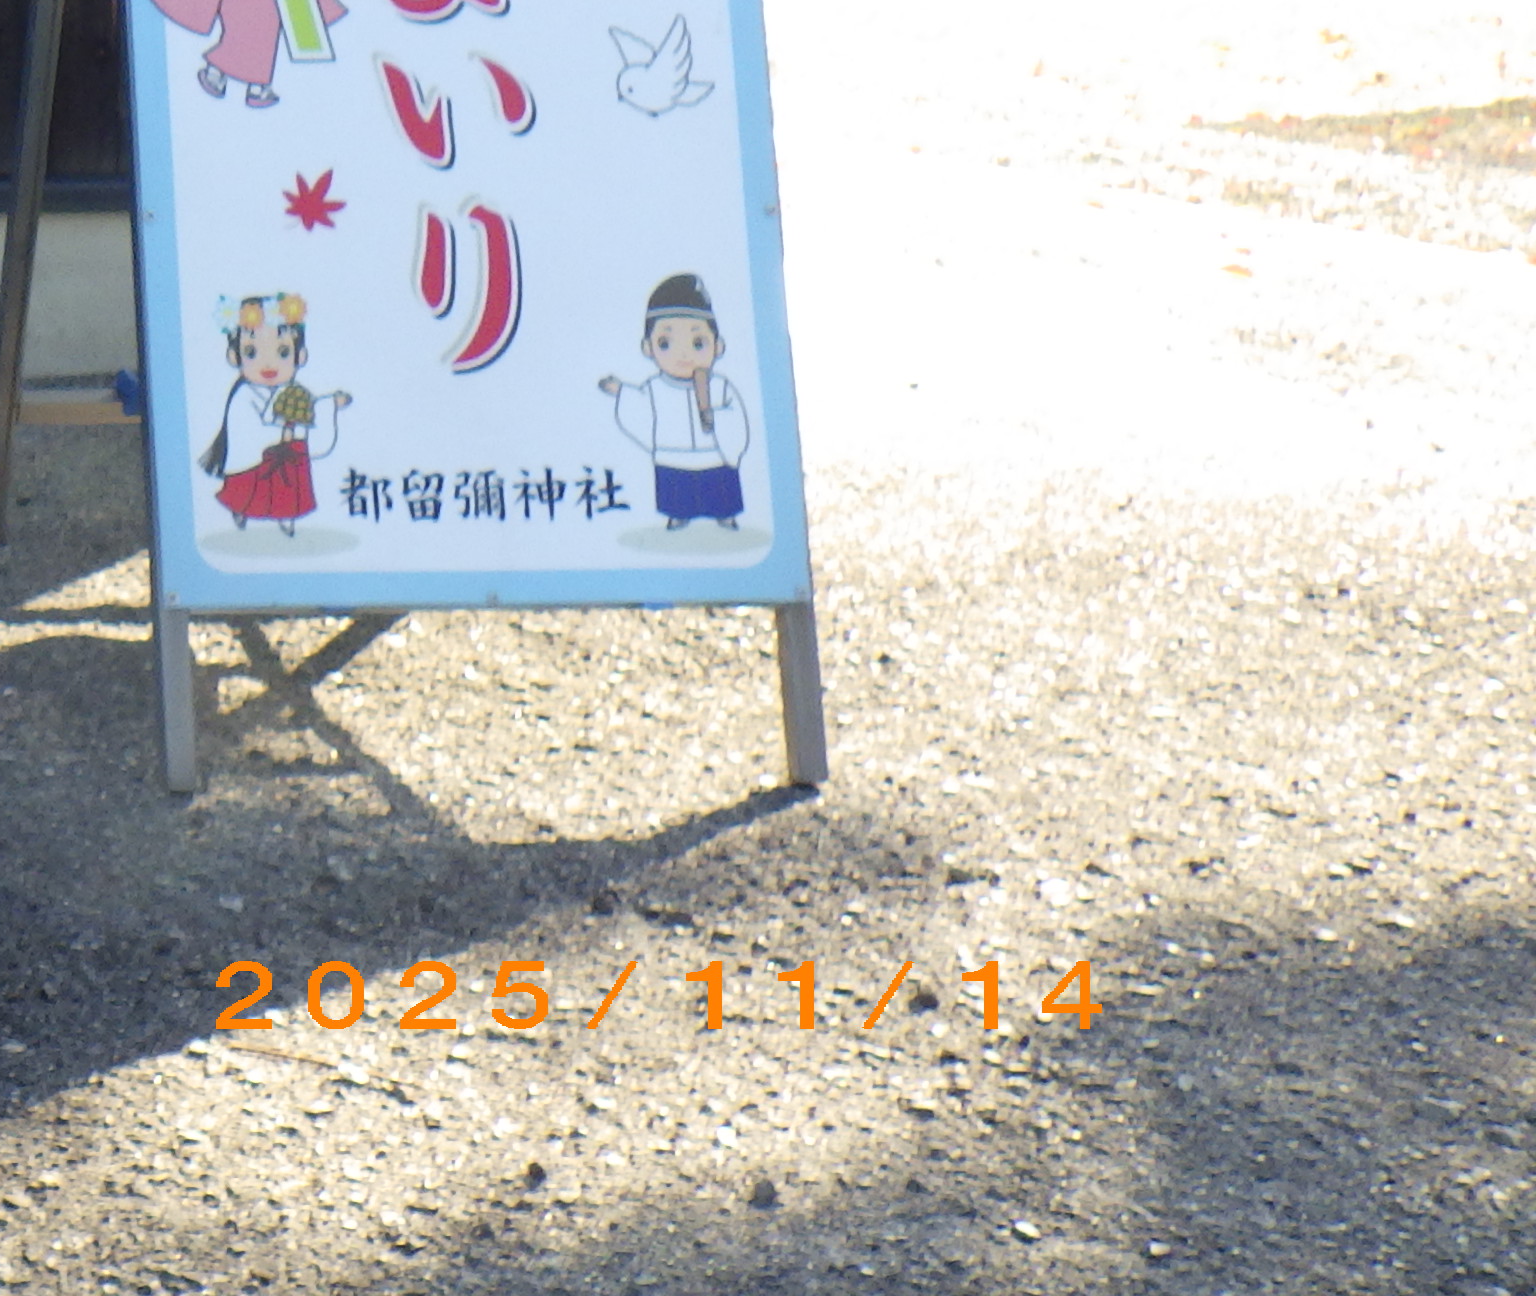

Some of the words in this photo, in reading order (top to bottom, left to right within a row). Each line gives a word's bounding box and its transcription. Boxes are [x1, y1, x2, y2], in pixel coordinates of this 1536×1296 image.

[339, 466, 632, 523] 都留彌神社
